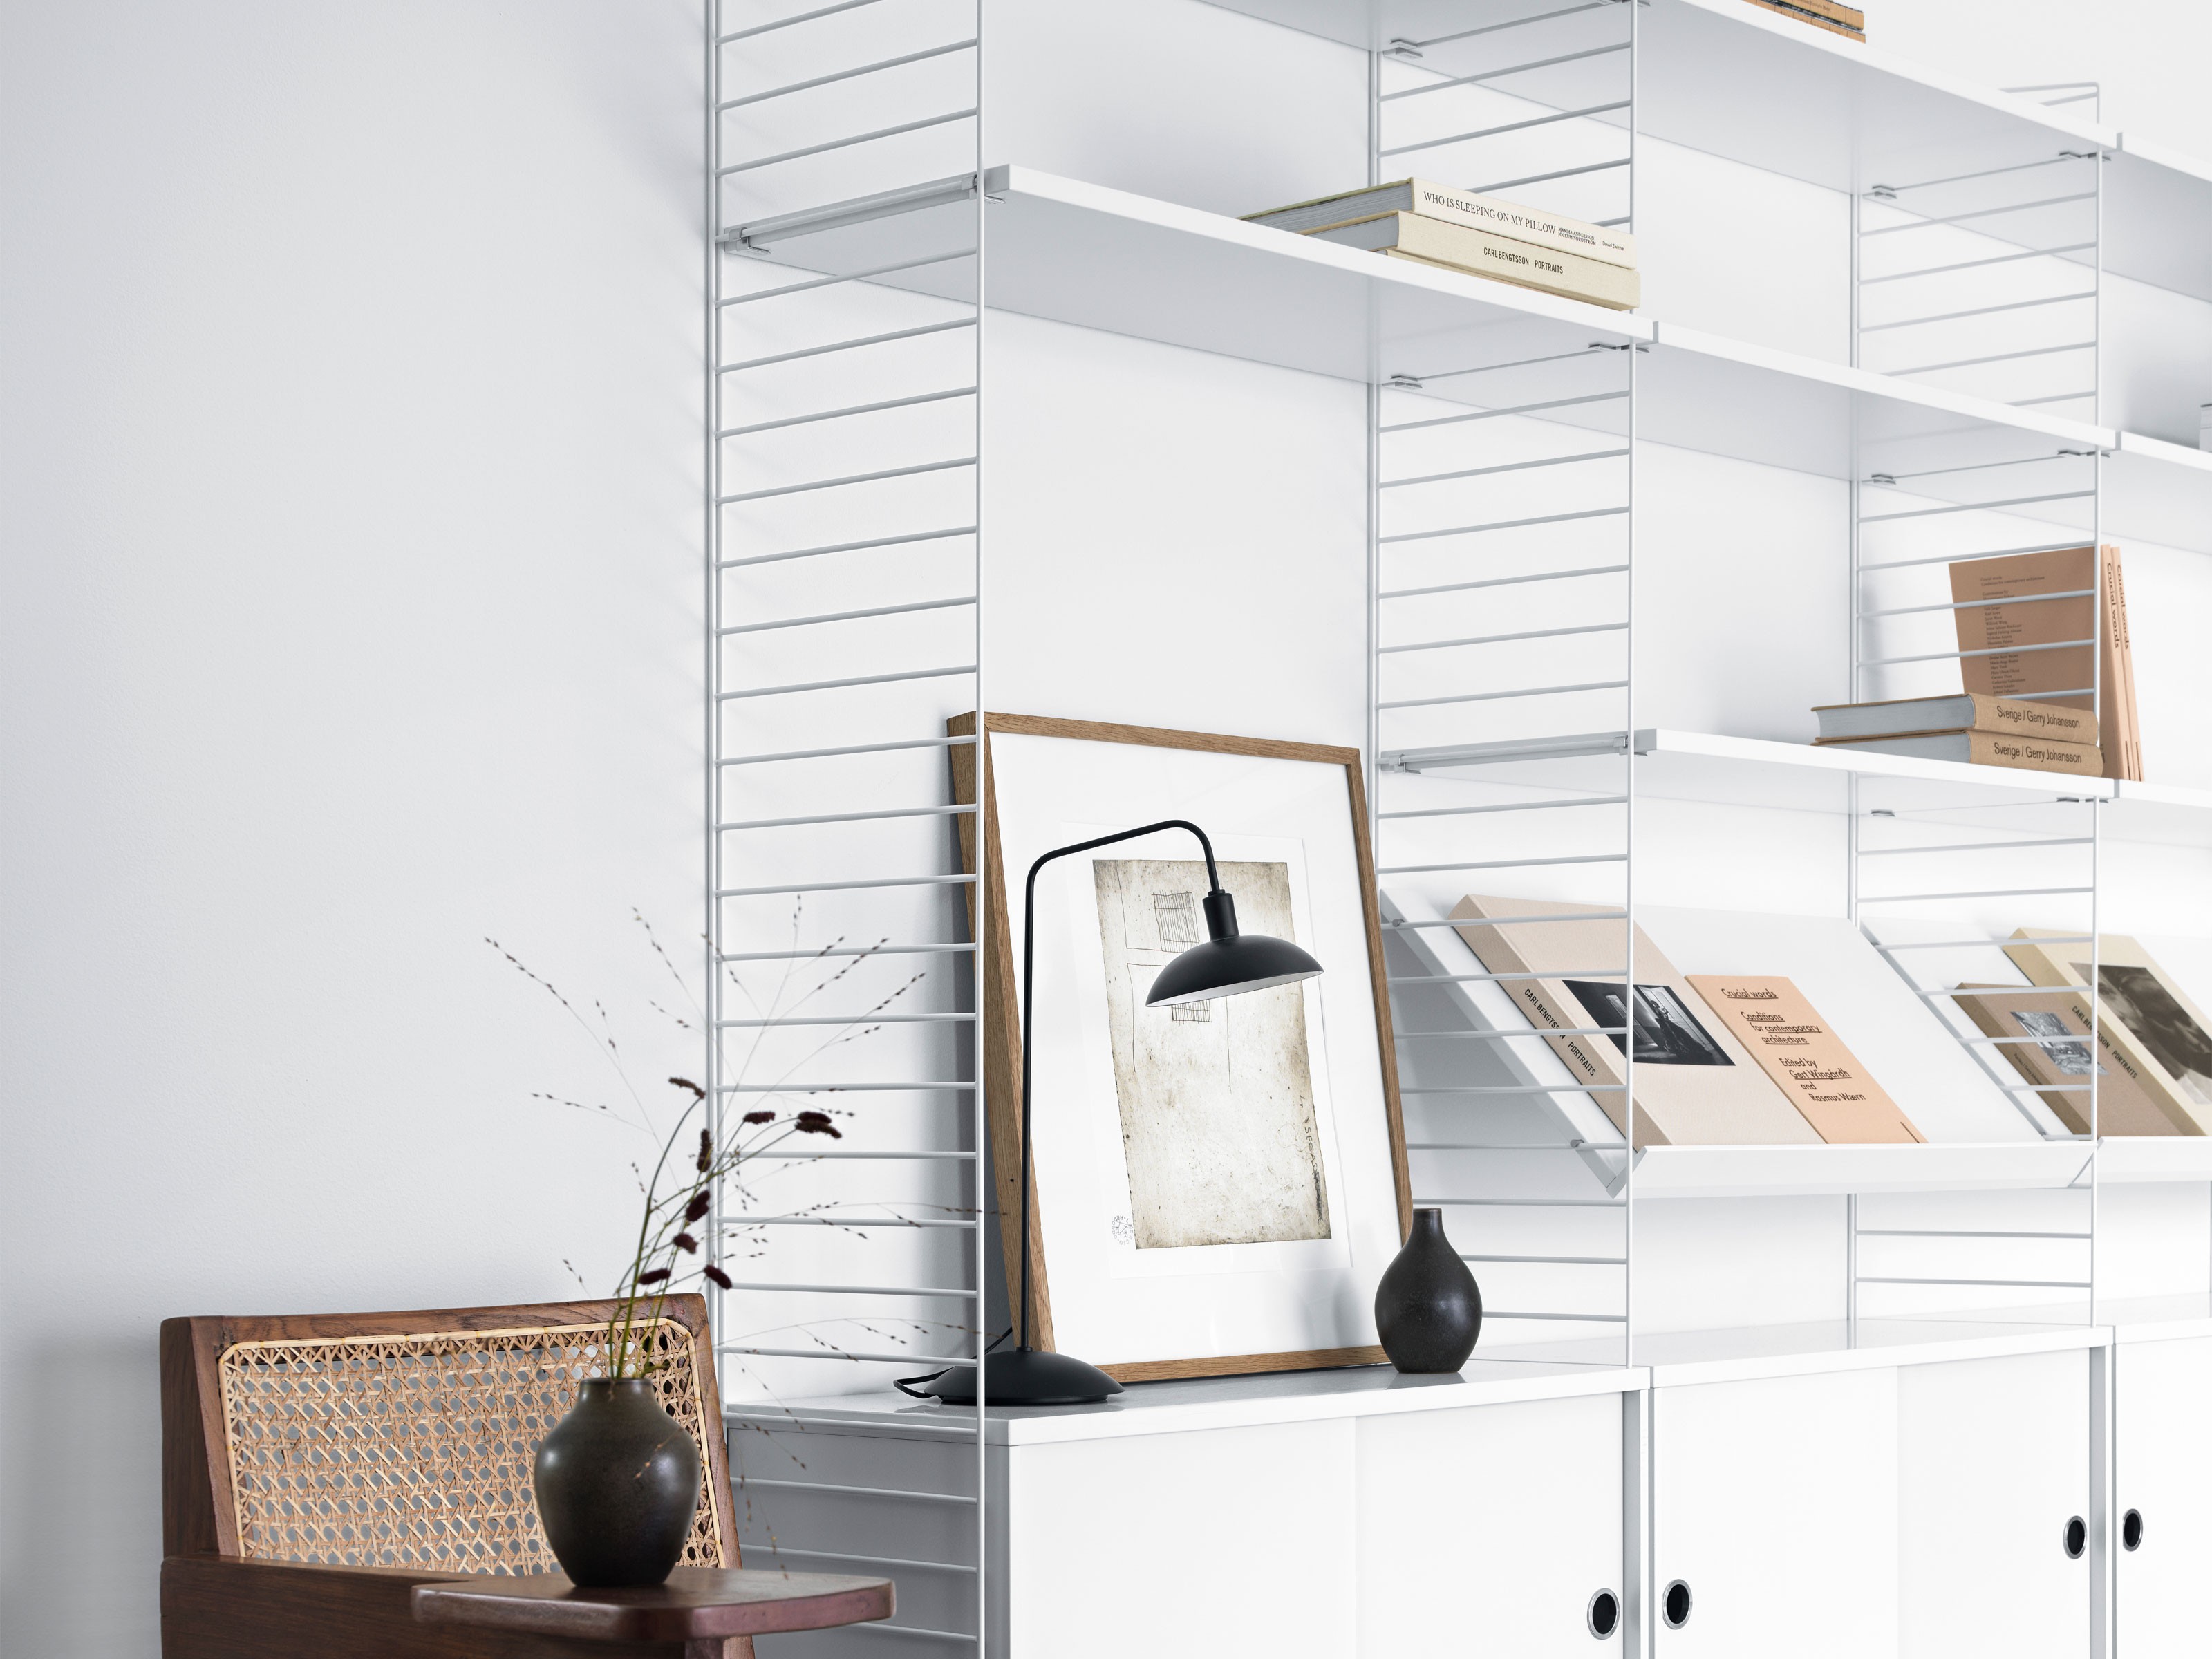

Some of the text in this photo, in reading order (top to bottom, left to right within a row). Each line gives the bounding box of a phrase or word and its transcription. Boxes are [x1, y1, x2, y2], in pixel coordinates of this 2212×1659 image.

[1424, 191, 1556, 234] WHO IS SLEEPING ON MY PILLOW
[1483, 247, 1563, 274] CARL BENGTSSON PORTRAITS
[1996, 705, 2022, 723] Sverige
[2027, 710, 2045, 727] Gerry
[2047, 713, 2080, 729] Johansson
[1994, 742, 2020, 759] Sverige
[2025, 746, 2045, 762] Gerry
[2046, 748, 2082, 764] Johansson
[1721, 988, 1777, 997] Crucial words
[1741, 1011, 1783, 1020] Conditions
[1524, 988, 1539, 1007] CARL
[1568, 1042, 1596, 1076] PORTRAITS
[1750, 1022, 1820, 1033] for contemporary
[1761, 1035, 1808, 1044] architecture
[2072, 1006, 2085, 1021] CARL
[2112, 1050, 2138, 1079] PORTRAITS
[1779, 1058, 1817, 1069] Edited by
[1789, 1068, 1850, 1080] Gert Wingårdh
[1801, 1081, 1817, 1090] and
[1808, 1093, 1841, 1101] Rasmus
